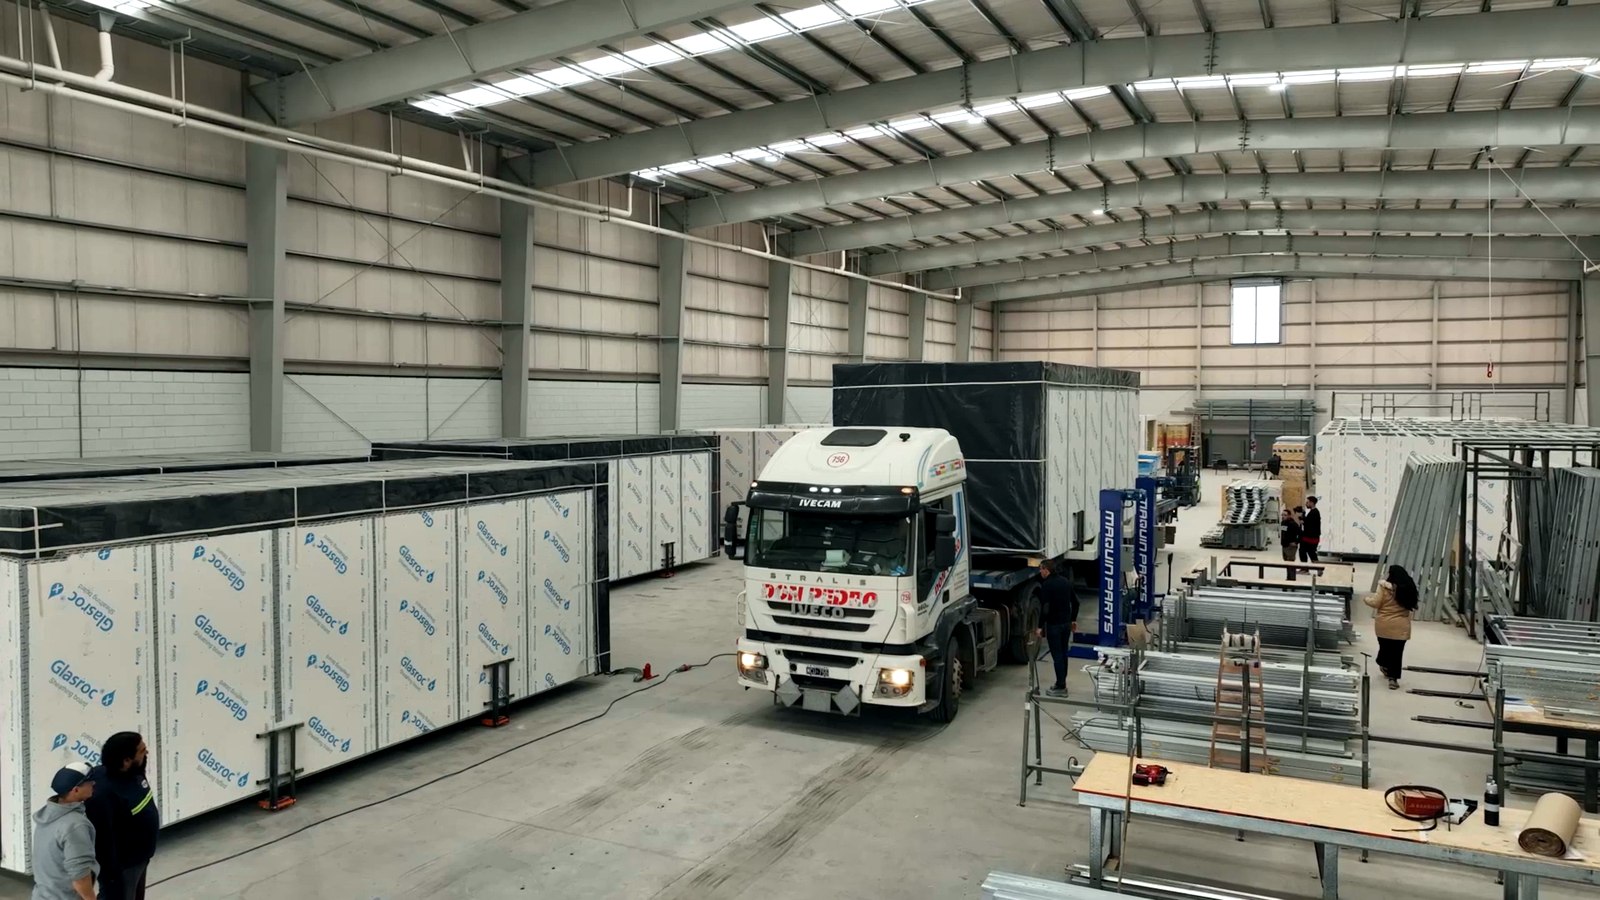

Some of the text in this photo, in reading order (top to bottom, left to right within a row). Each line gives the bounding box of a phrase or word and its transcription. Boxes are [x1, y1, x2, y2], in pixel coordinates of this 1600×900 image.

[832, 455, 846, 464] 756
[799, 499, 842, 508] IVECAM
[477, 520, 500, 550] Glasroc
[551, 536, 570, 563] Glasroc
[317, 540, 347, 574] Glasroc
[399, 545, 425, 576] Glasroc
[1103, 510, 1114, 634] MAQUIN PARTS
[208, 554, 245, 591] Glasroc
[770, 572, 866, 586] STRALIS
[486, 576, 508, 605] Glasroc
[544, 578, 563, 604] Glasroc
[761, 583, 878, 608] DON PEDRO
[67, 591, 113, 632] Glasroc
[306, 595, 337, 628] Glasroc
[410, 606, 435, 636] Glasroc
[790, 602, 845, 619] IVECO
[195, 614, 233, 651] Glasroc
[479, 623, 500, 650] Glasroc
[552, 629, 571, 655] Glasroc
[50, 660, 98, 699] Glasroc
[319, 661, 349, 692] Glasroc
[400, 656, 426, 686] Glasroc
[211, 687, 248, 721] Glasroc
[308, 716, 339, 747] Glasroc
[198, 748, 235, 782] Glasroc
